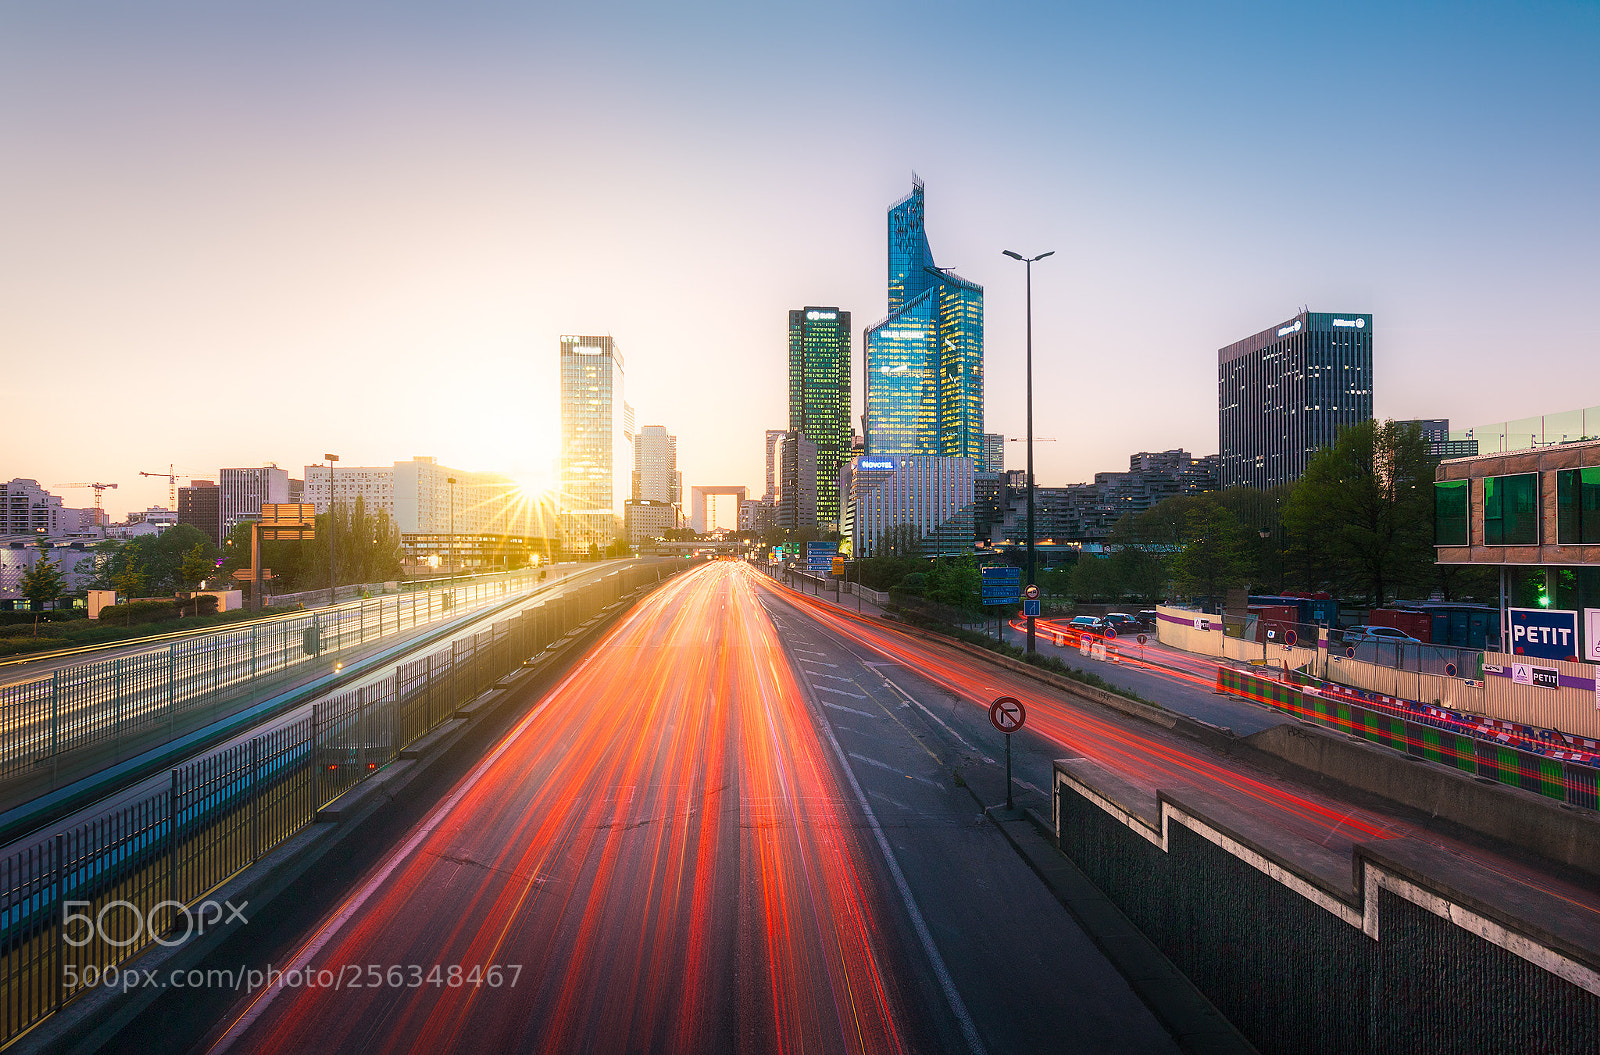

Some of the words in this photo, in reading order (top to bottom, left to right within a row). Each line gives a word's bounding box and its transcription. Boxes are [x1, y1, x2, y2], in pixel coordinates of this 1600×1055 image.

[862, 461, 893, 469] NOVOTEL
[1513, 624, 1572, 646] PETIT
[1533, 672, 1557, 684] PETIT
